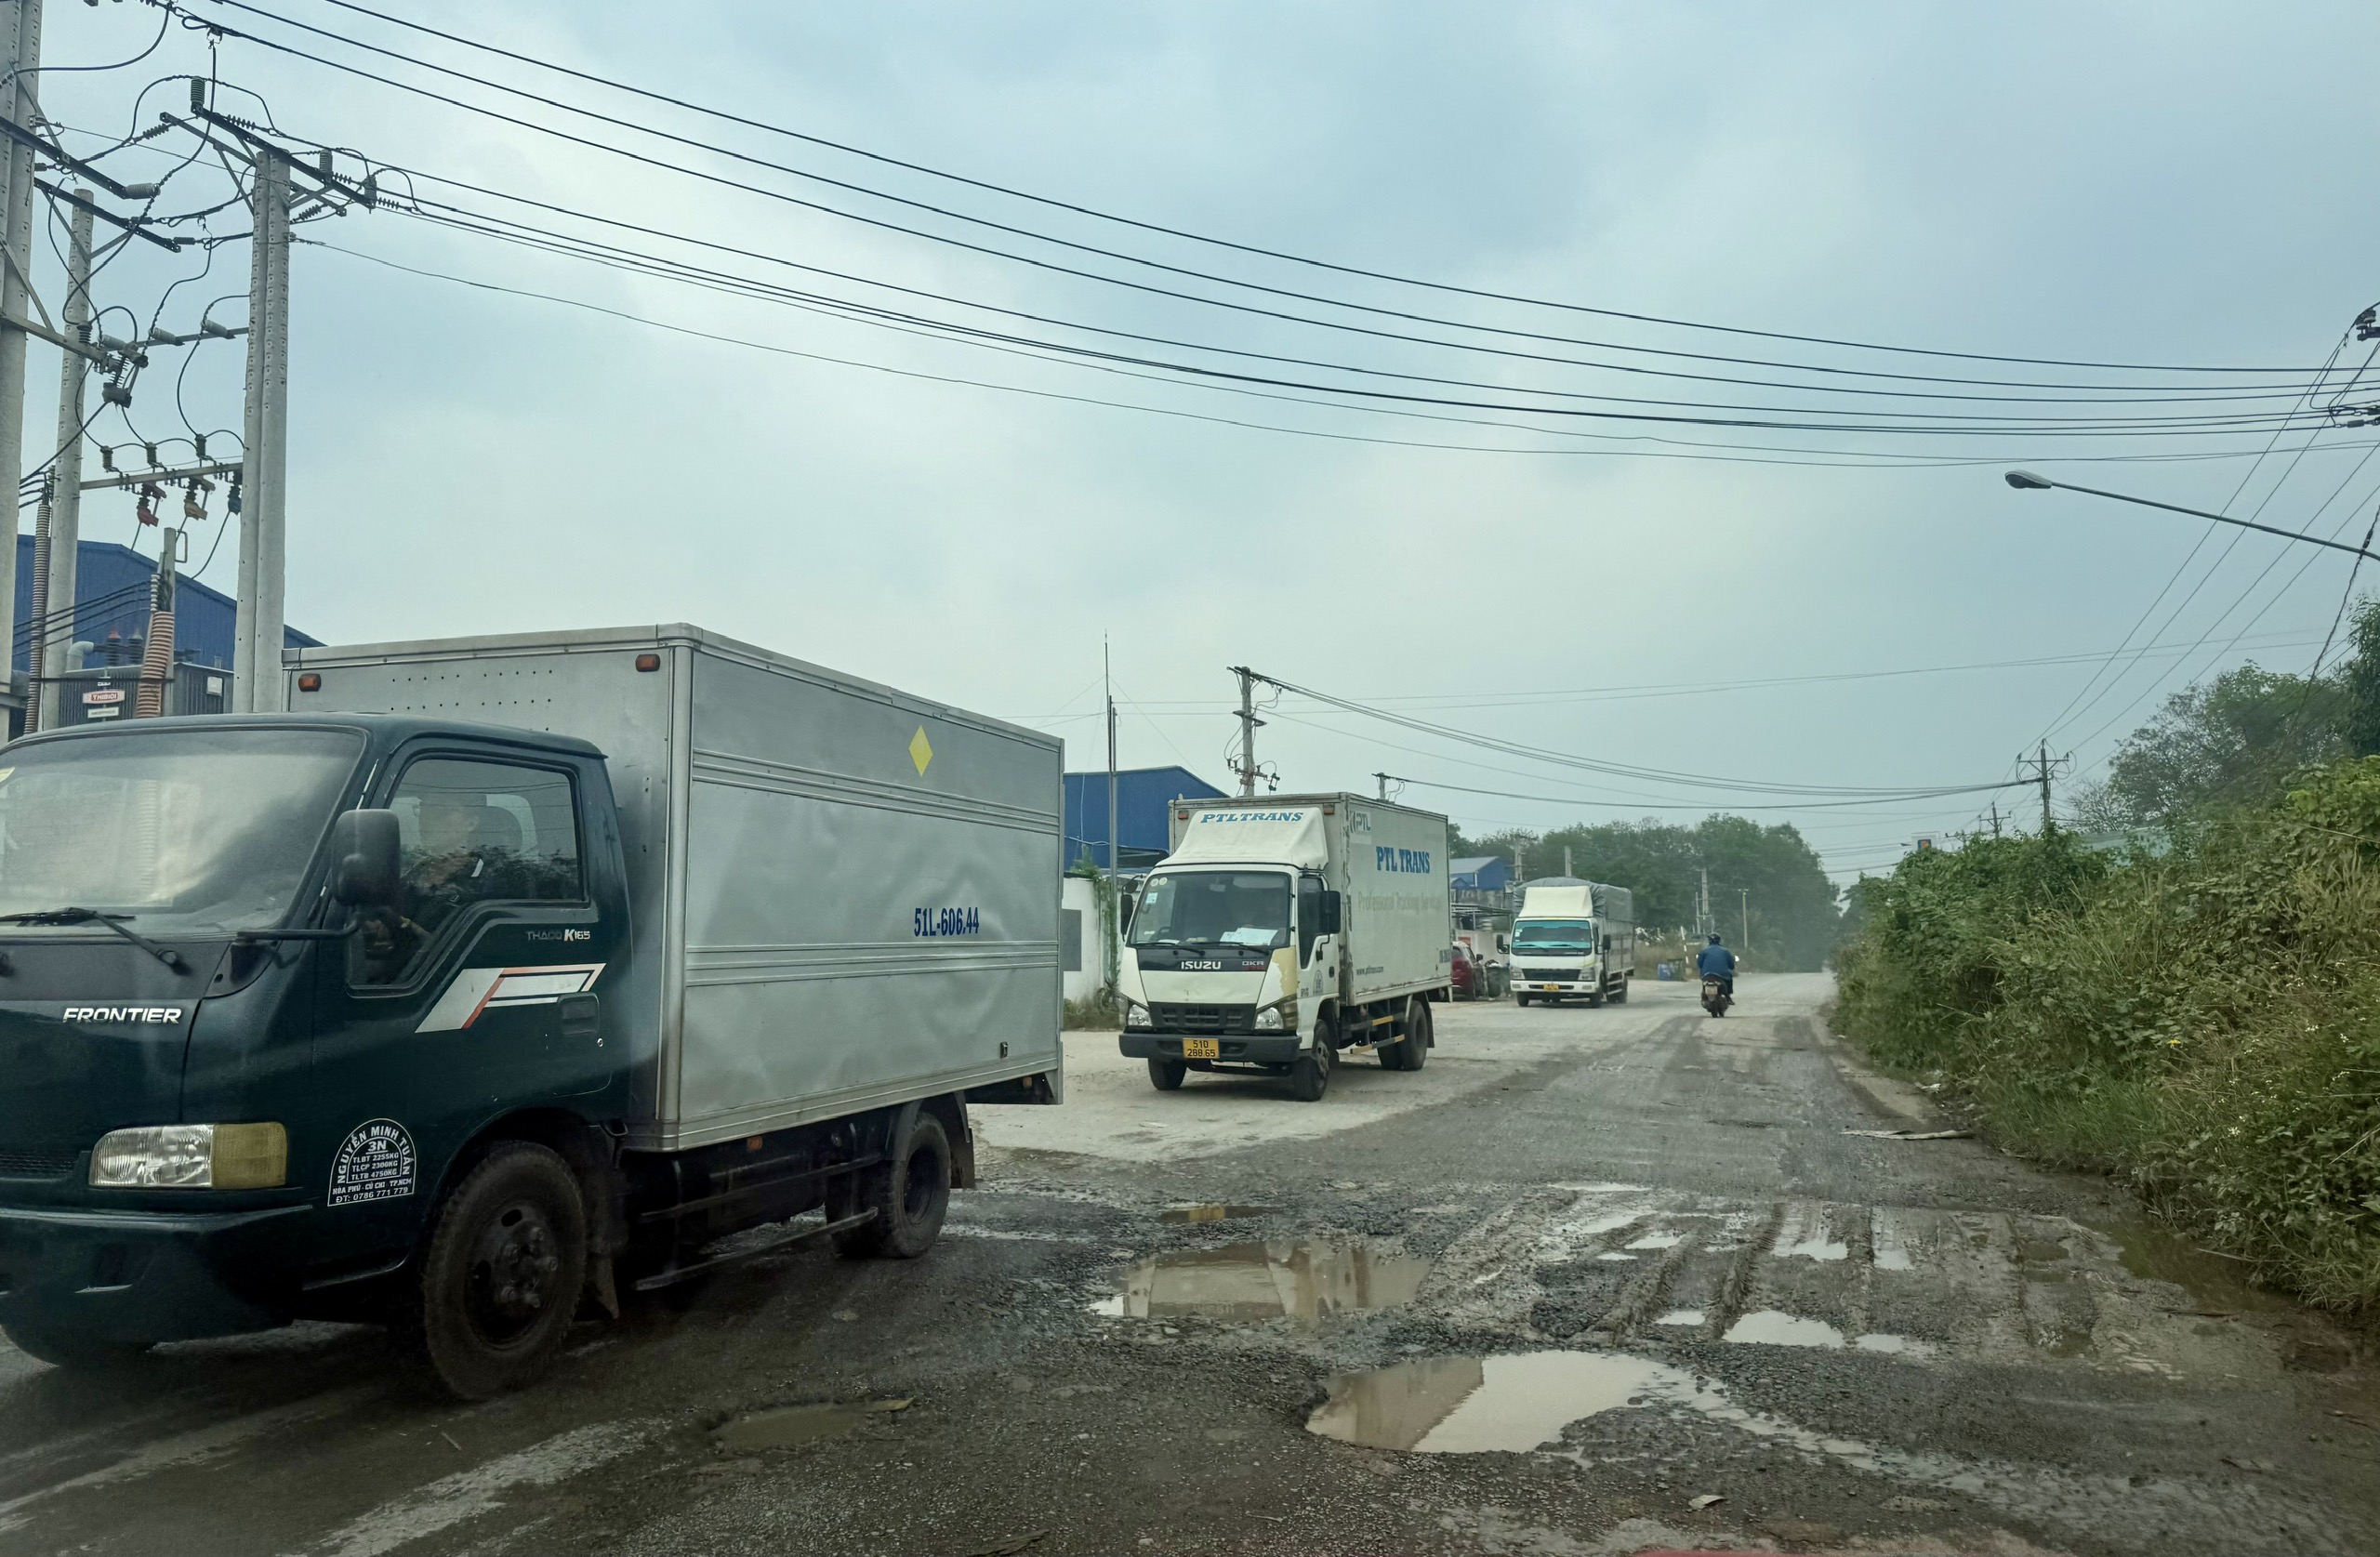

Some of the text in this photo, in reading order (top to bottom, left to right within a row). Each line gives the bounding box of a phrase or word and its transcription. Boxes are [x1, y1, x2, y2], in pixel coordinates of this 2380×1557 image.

[1376, 845, 1430, 874] PTL TRANS
[914, 906, 980, 937] 51L-606.44
[563, 929, 590, 942] K165
[1181, 960, 1222, 970] ISUZU
[62, 1007, 182, 1023] FRONTIER
[370, 1126, 399, 1141] MINH
[368, 1140, 387, 1152] 3N
[353, 1192, 374, 1201] 0786
[377, 1189, 390, 1197] 771
[394, 1186, 408, 1194] 779
